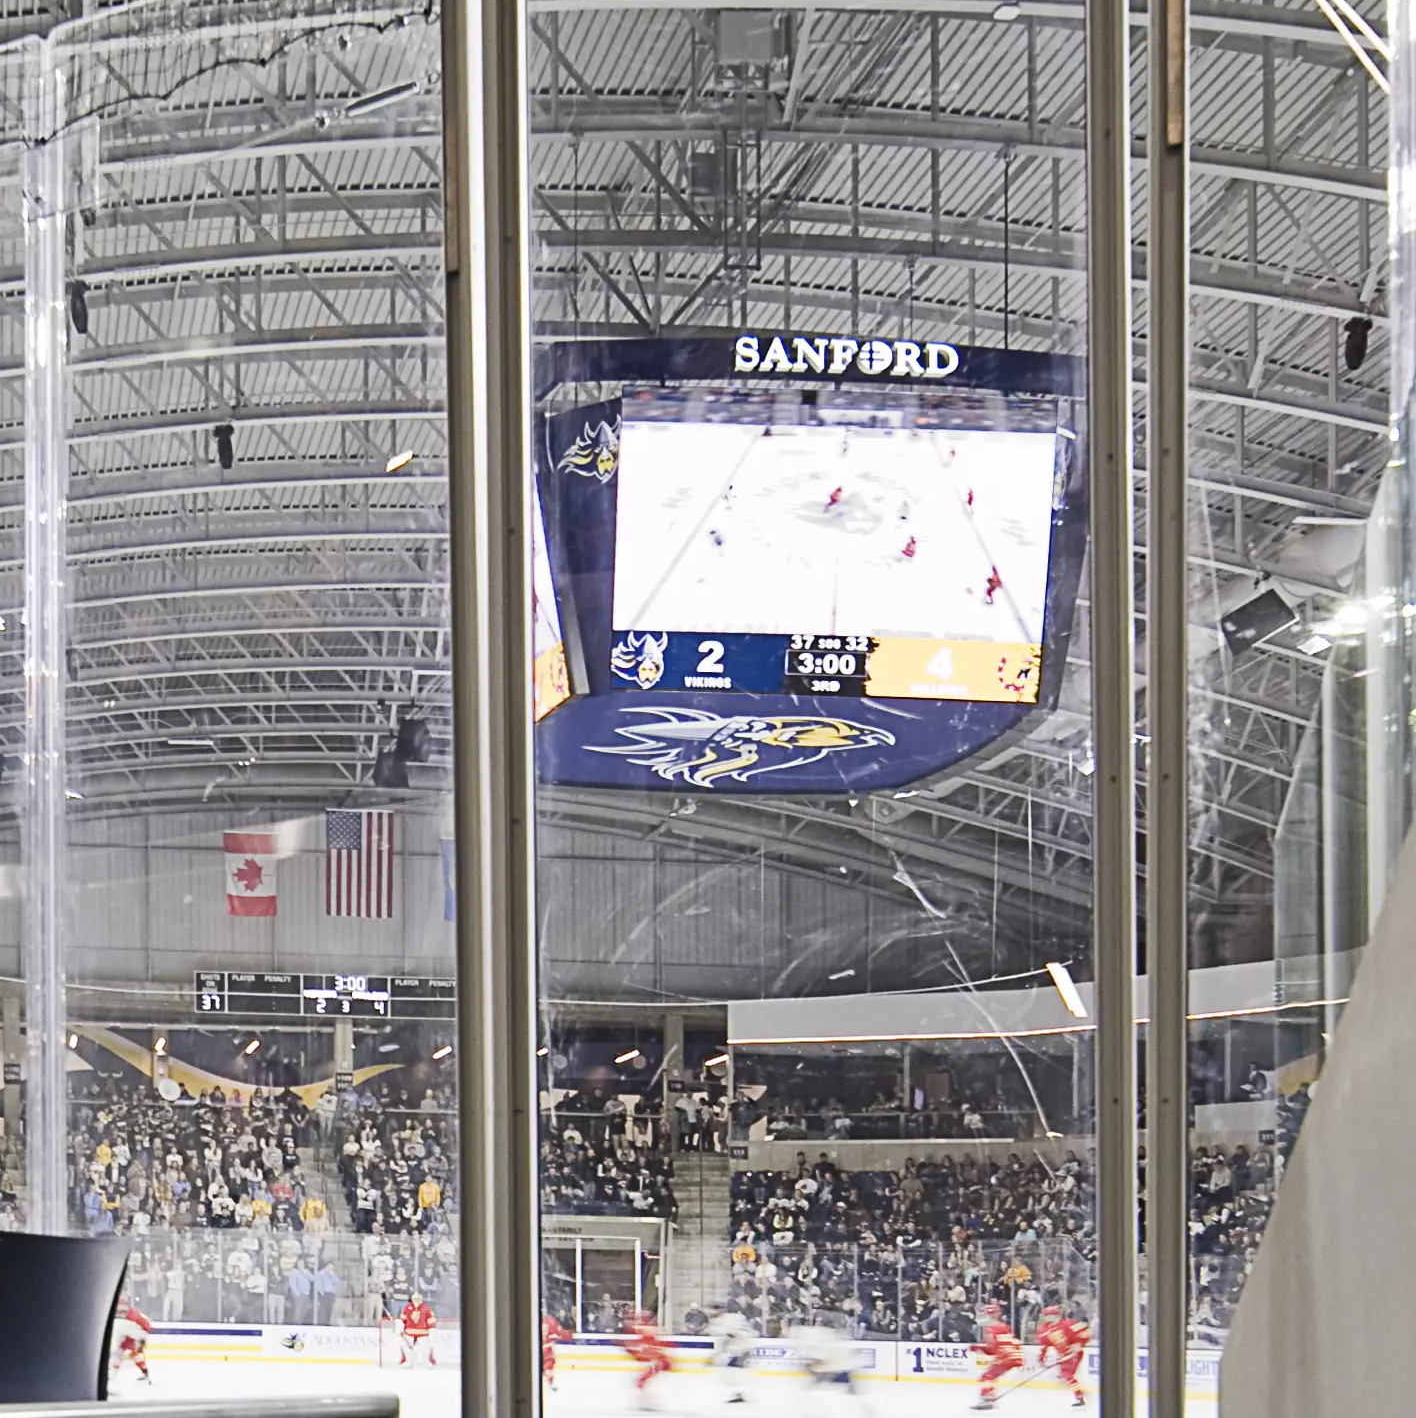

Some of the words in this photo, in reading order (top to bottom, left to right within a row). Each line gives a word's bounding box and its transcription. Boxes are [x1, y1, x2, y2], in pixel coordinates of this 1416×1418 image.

[734, 335, 960, 379] SANFORD
[790, 635, 815, 650] 37
[845, 636, 869, 652] 32
[696, 640, 725, 674] 2
[797, 652, 856, 676] 3:00
[926, 647, 954, 681] 4
[231, 974, 256, 982] PLAYER
[264, 975, 292, 983] PENALTY
[334, 975, 367, 991] 3:00
[201, 994, 221, 1010] 37
[316, 998, 327, 1014] 2
[341, 1000, 351, 1014] 3
[373, 1001, 385, 1015] 4
[926, 1348, 969, 1359] NCLEX
